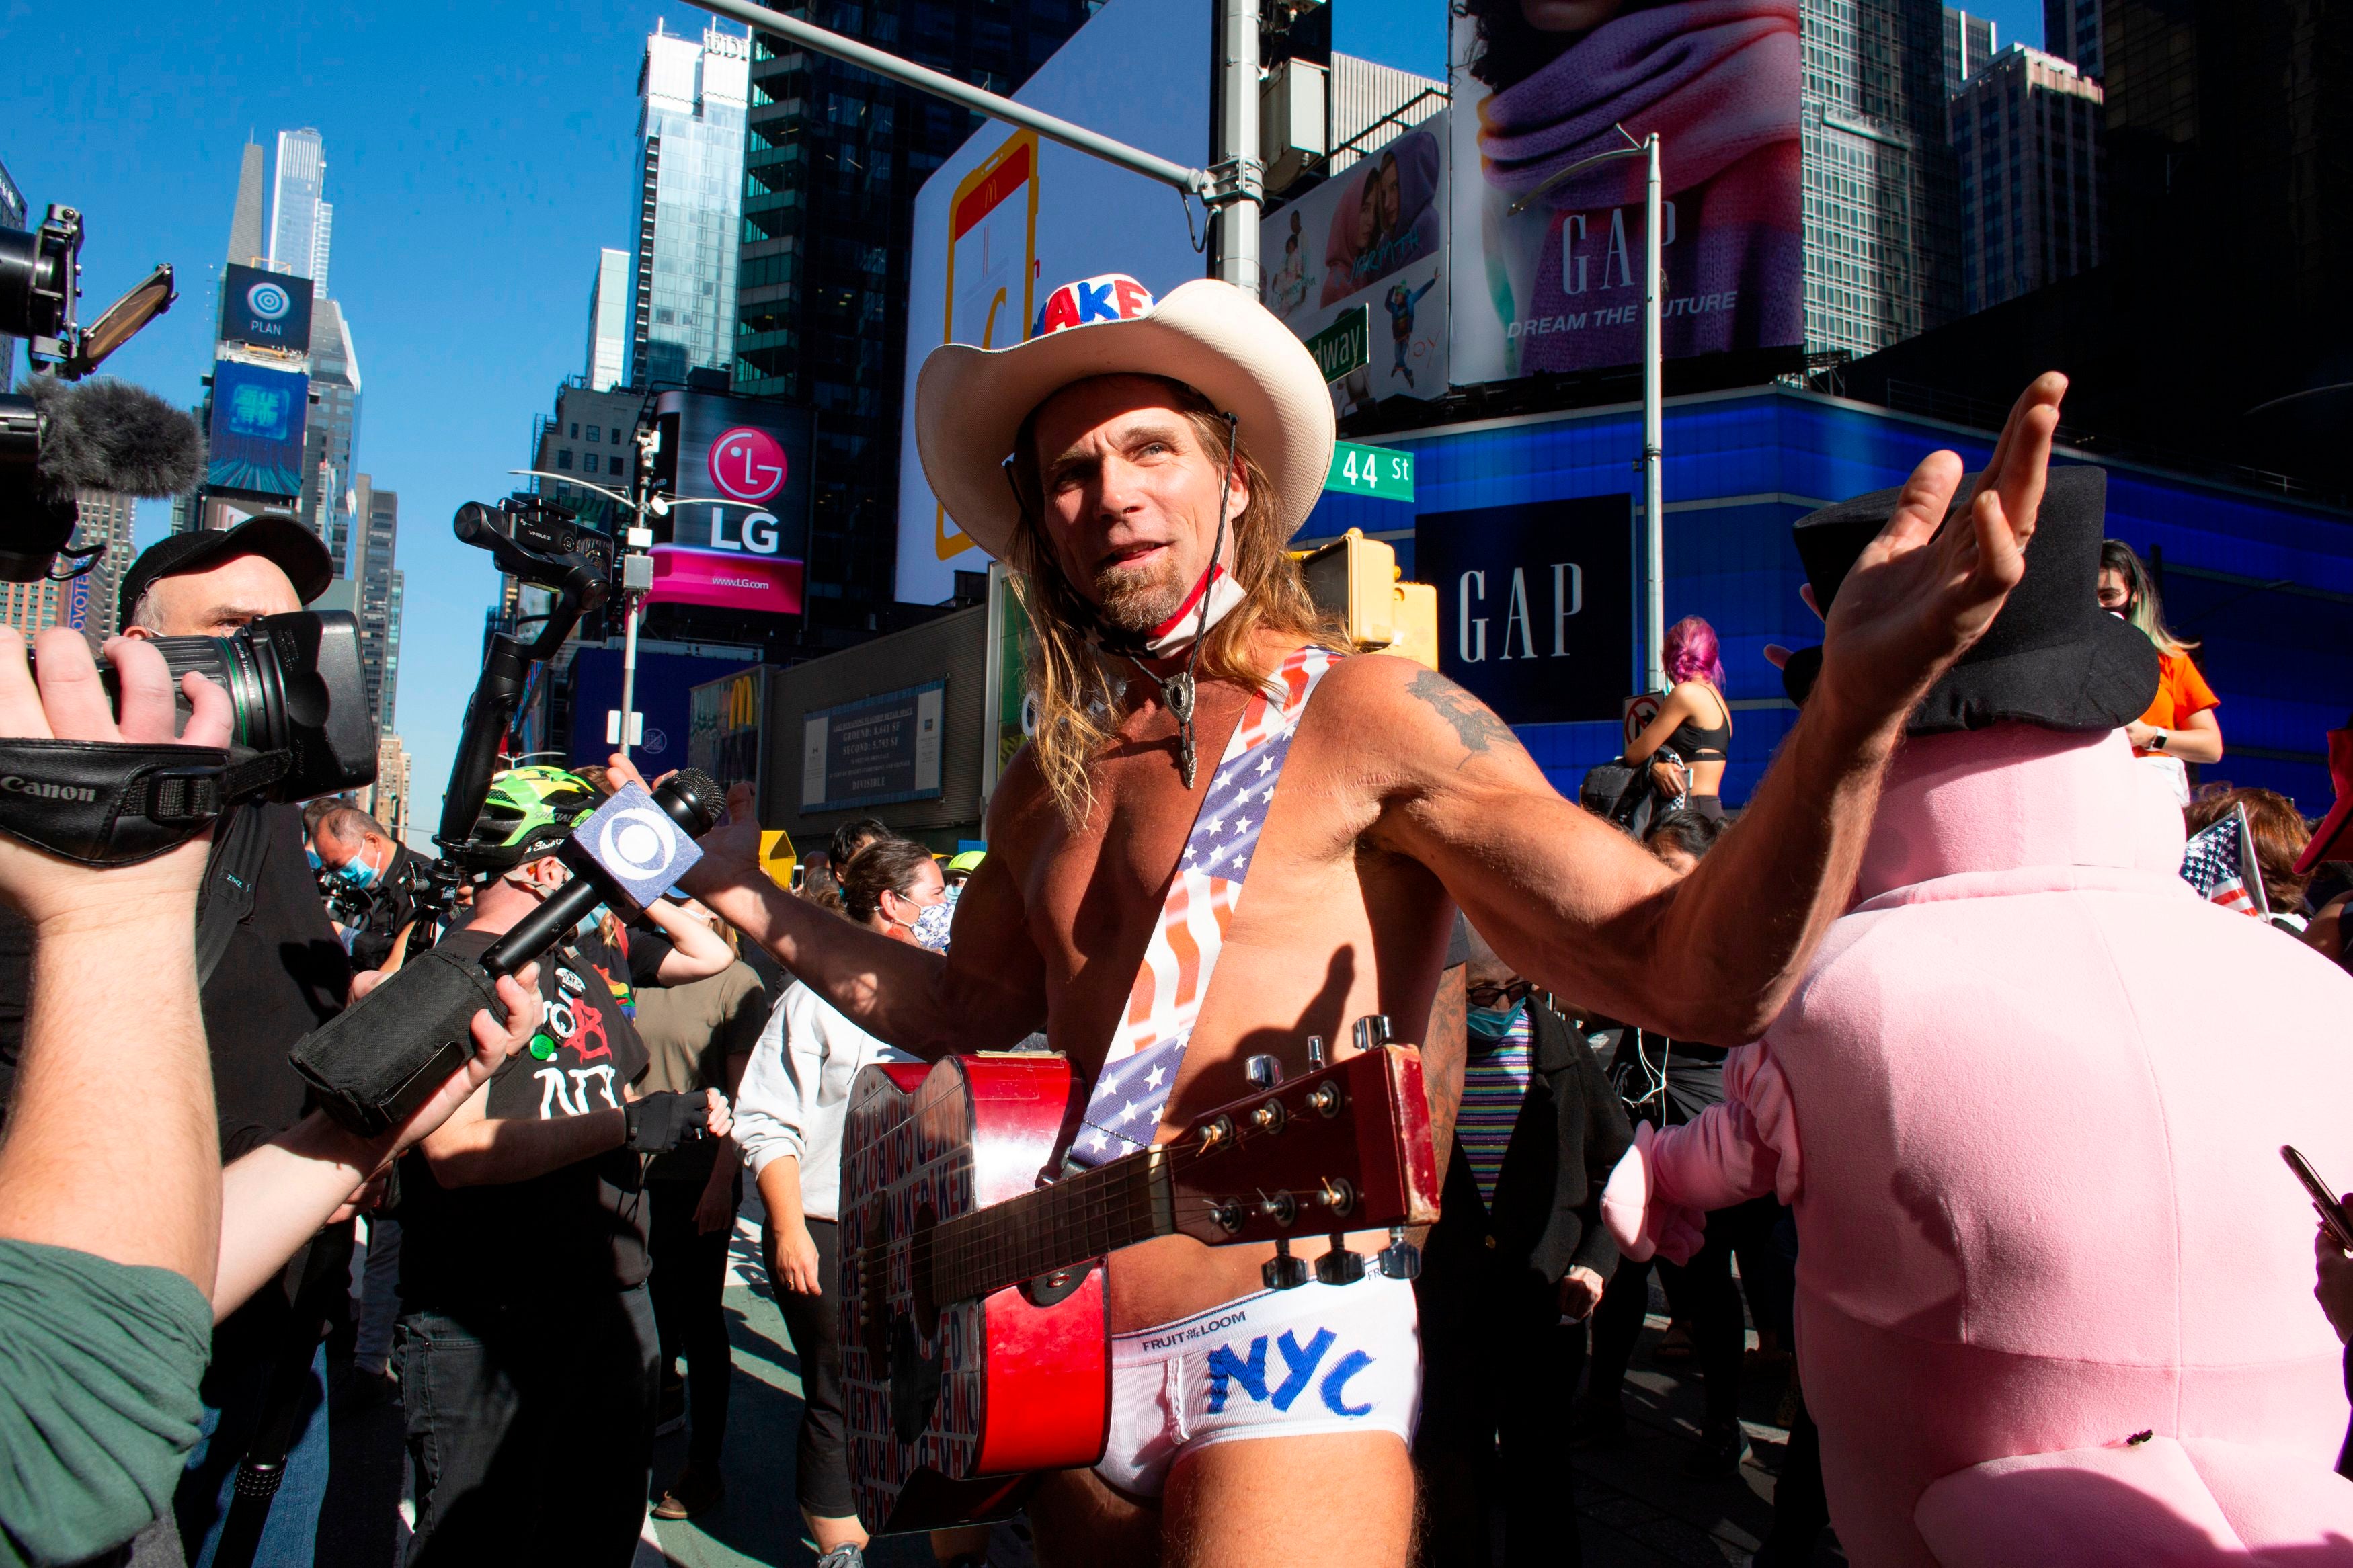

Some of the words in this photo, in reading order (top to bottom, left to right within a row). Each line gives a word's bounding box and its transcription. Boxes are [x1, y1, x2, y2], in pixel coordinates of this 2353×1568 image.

[251, 320, 282, 335] PLAN
[1030, 280, 1158, 339] AKE
[1507, 311, 1587, 339] DREAM
[1594, 305, 1638, 327] THE
[1661, 290, 1738, 318] UTURE
[1343, 450, 1378, 489] 44
[1392, 457, 1409, 481] St
[711, 507, 779, 554] LG
[72, 573, 89, 632] OVOTE
[712, 577, 769, 589] www.LG.com
[1460, 563, 1583, 663] GAP
[842, 742, 871, 755] SECOND:
[0, 776, 95, 802] Canon
[852, 776, 886, 790] DIVISIBLE
[1144, 1332, 1185, 1352] FRUIT
[1201, 1311, 1246, 1335] LOOM
[1207, 1327, 1377, 1418] NYC
